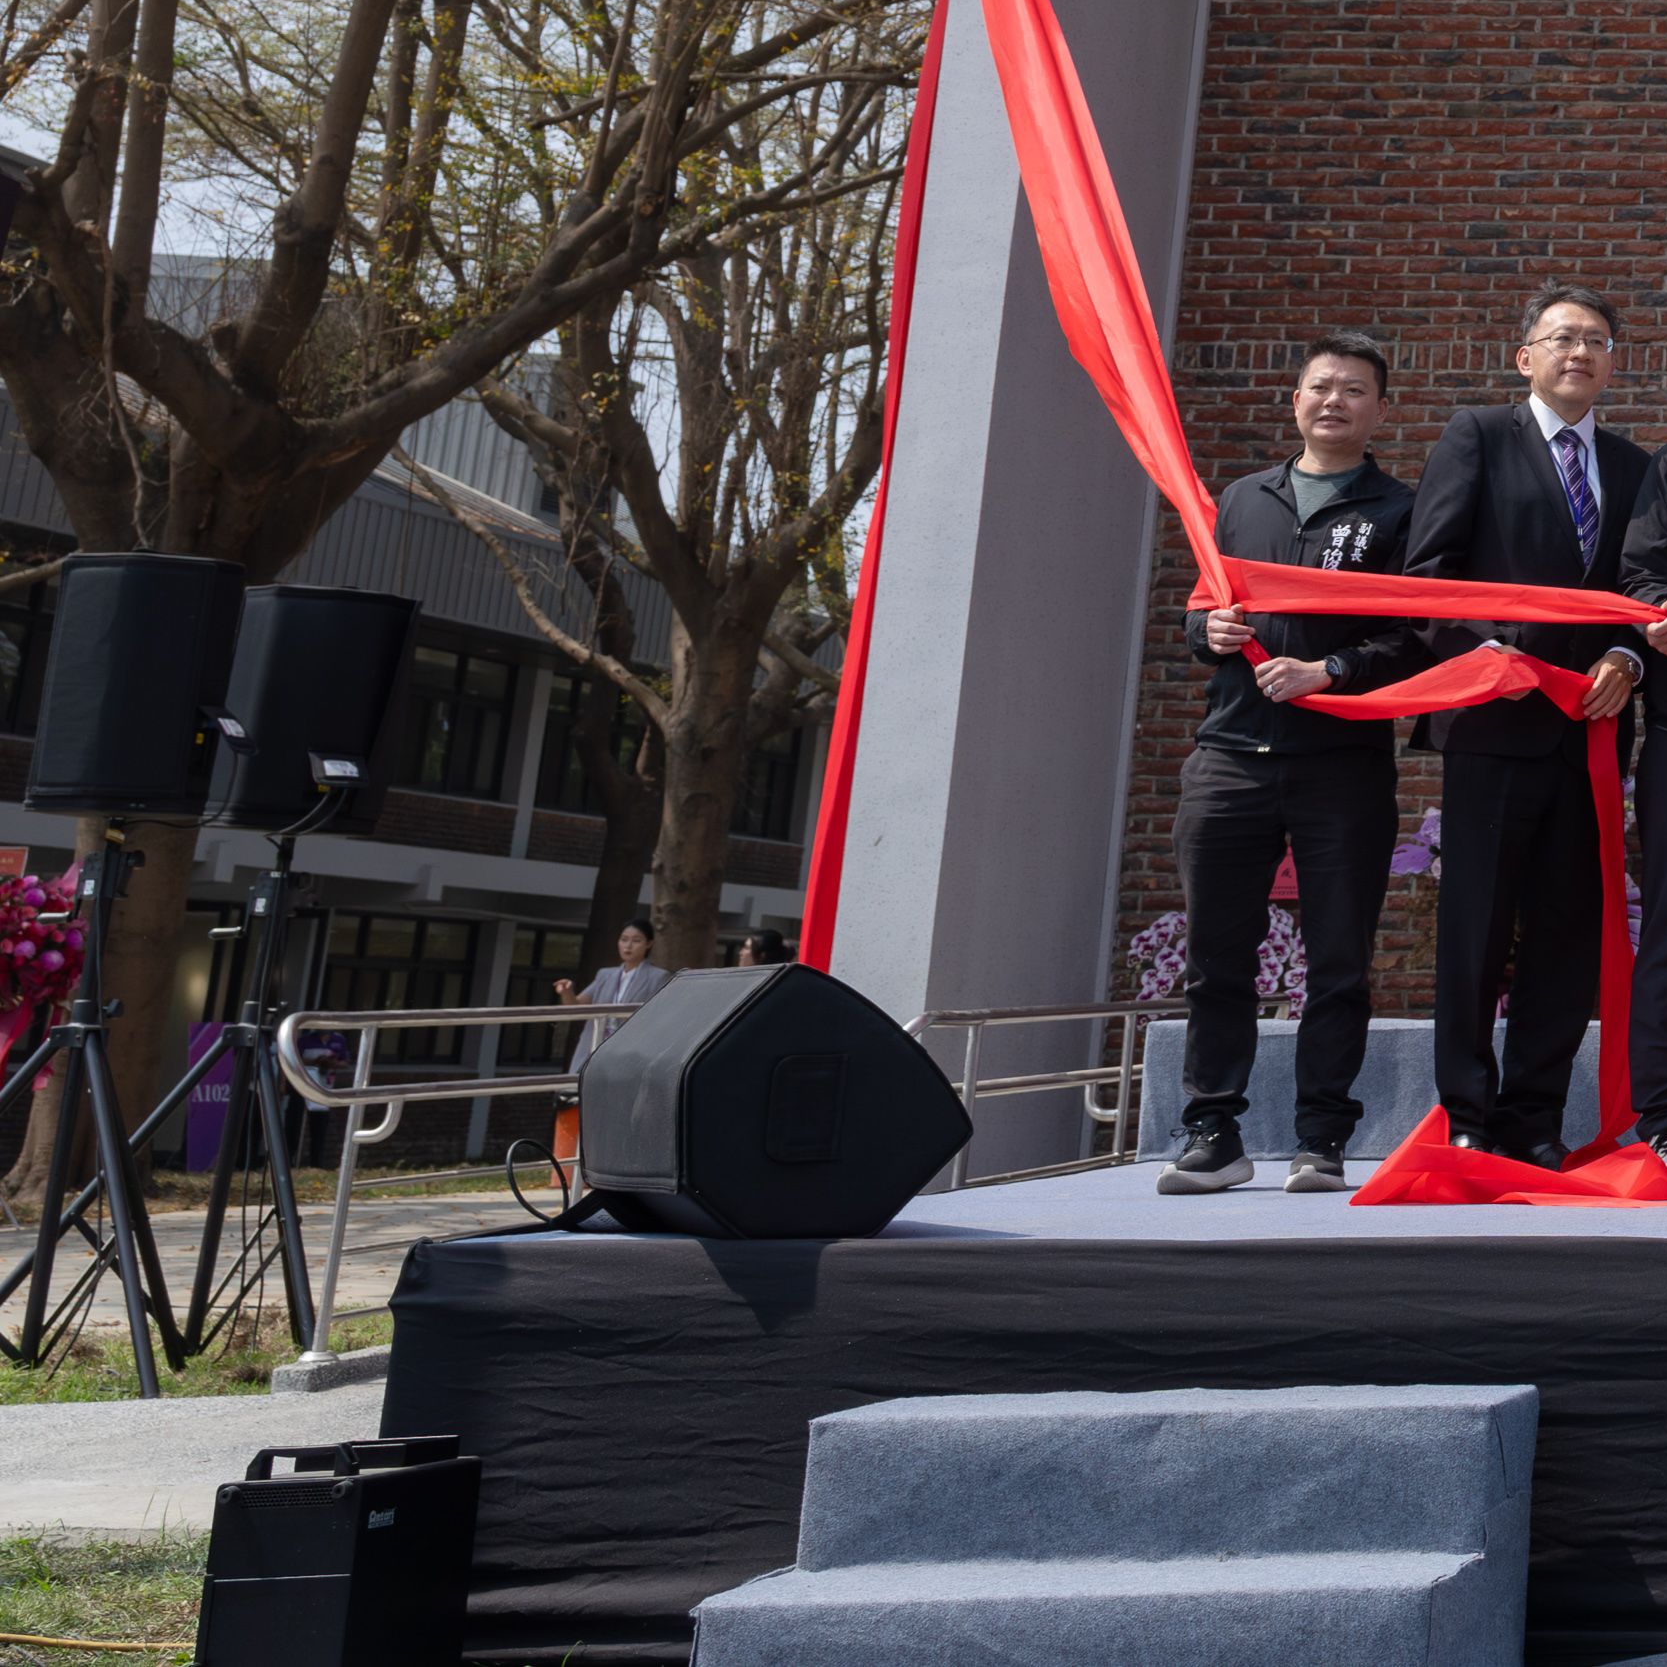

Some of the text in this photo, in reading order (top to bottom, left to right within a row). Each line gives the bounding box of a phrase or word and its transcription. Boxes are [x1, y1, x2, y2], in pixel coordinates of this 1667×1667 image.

[1350, 522, 1374, 563] 副議長
[191, 1083, 231, 1103] A102
